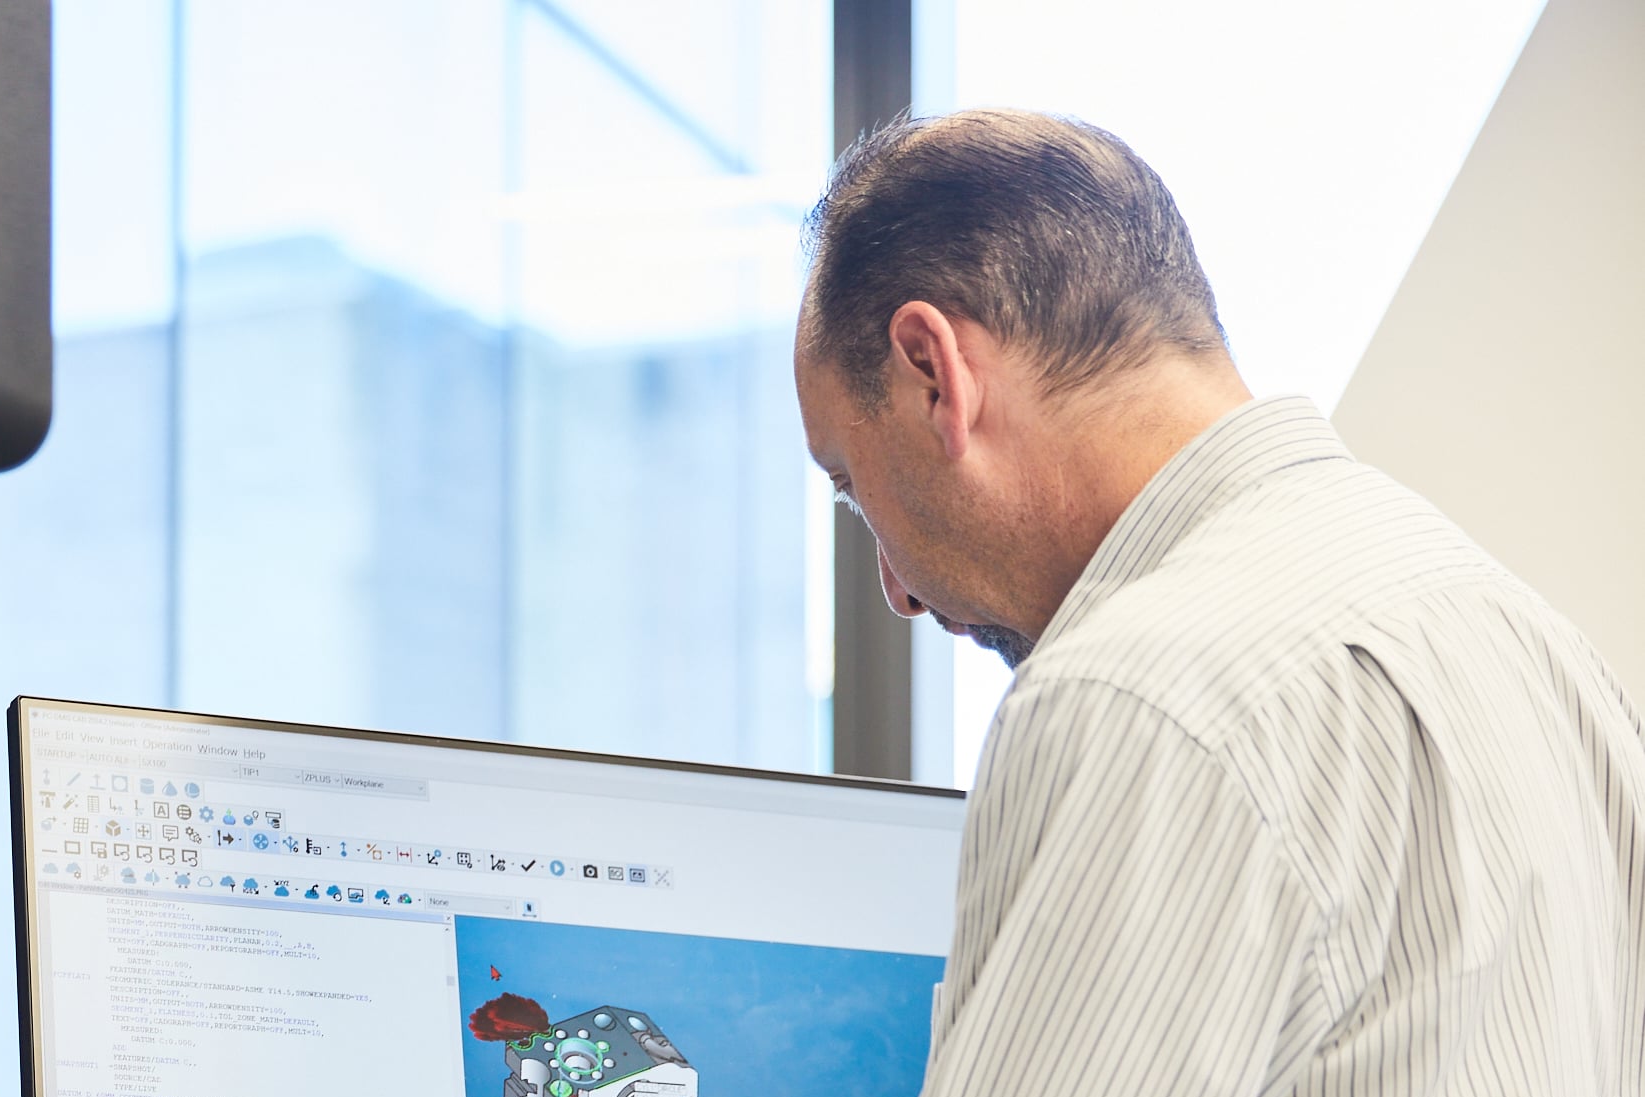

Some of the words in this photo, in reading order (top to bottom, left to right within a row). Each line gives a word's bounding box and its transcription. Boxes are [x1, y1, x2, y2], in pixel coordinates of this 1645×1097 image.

[79, 732, 104, 743] View
[109, 735, 137, 747] Insert
[142, 738, 191, 752] Operation
[196, 743, 237, 756] Window
[243, 748, 266, 760] Help
[241, 767, 259, 776] TIP1
[303, 773, 331, 784] ZPLUS
[343, 777, 384, 790] Workplane
[429, 897, 448, 906] None
